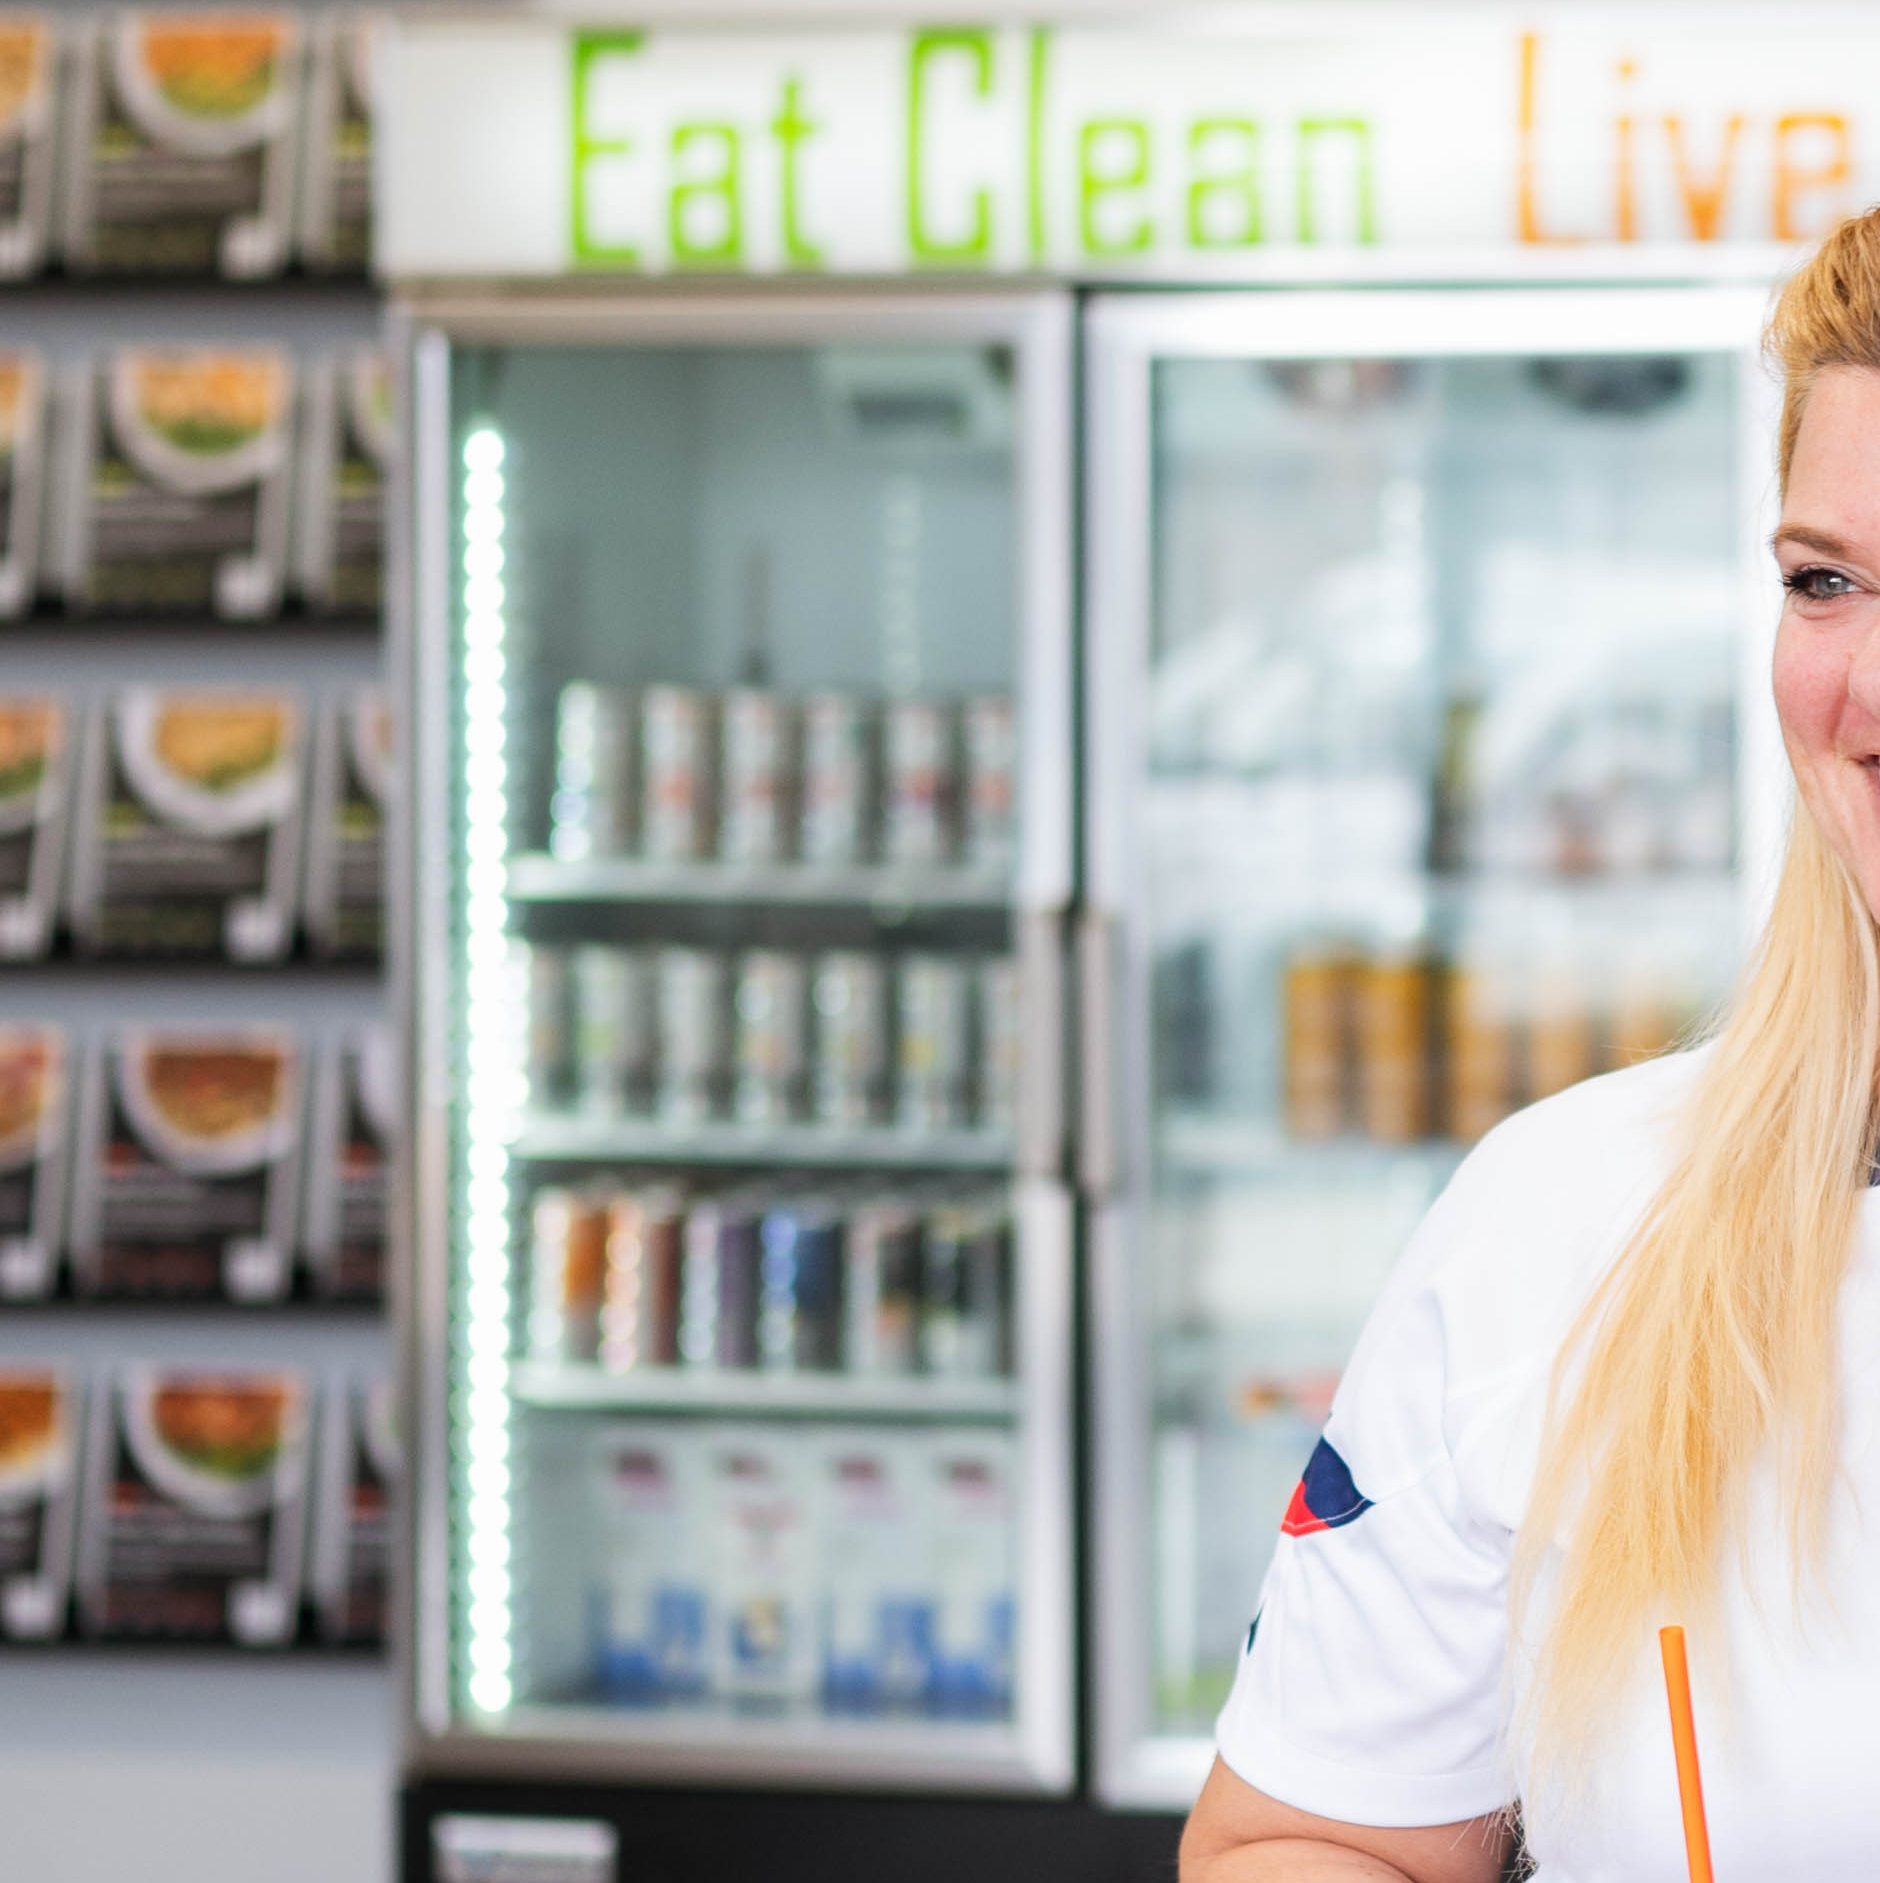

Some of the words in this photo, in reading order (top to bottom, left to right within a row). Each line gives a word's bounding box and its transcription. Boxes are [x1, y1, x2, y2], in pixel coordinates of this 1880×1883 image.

[568, 25, 824, 269] Eat
[906, 23, 1379, 267] Clean
[1512, 29, 1854, 245] Live
